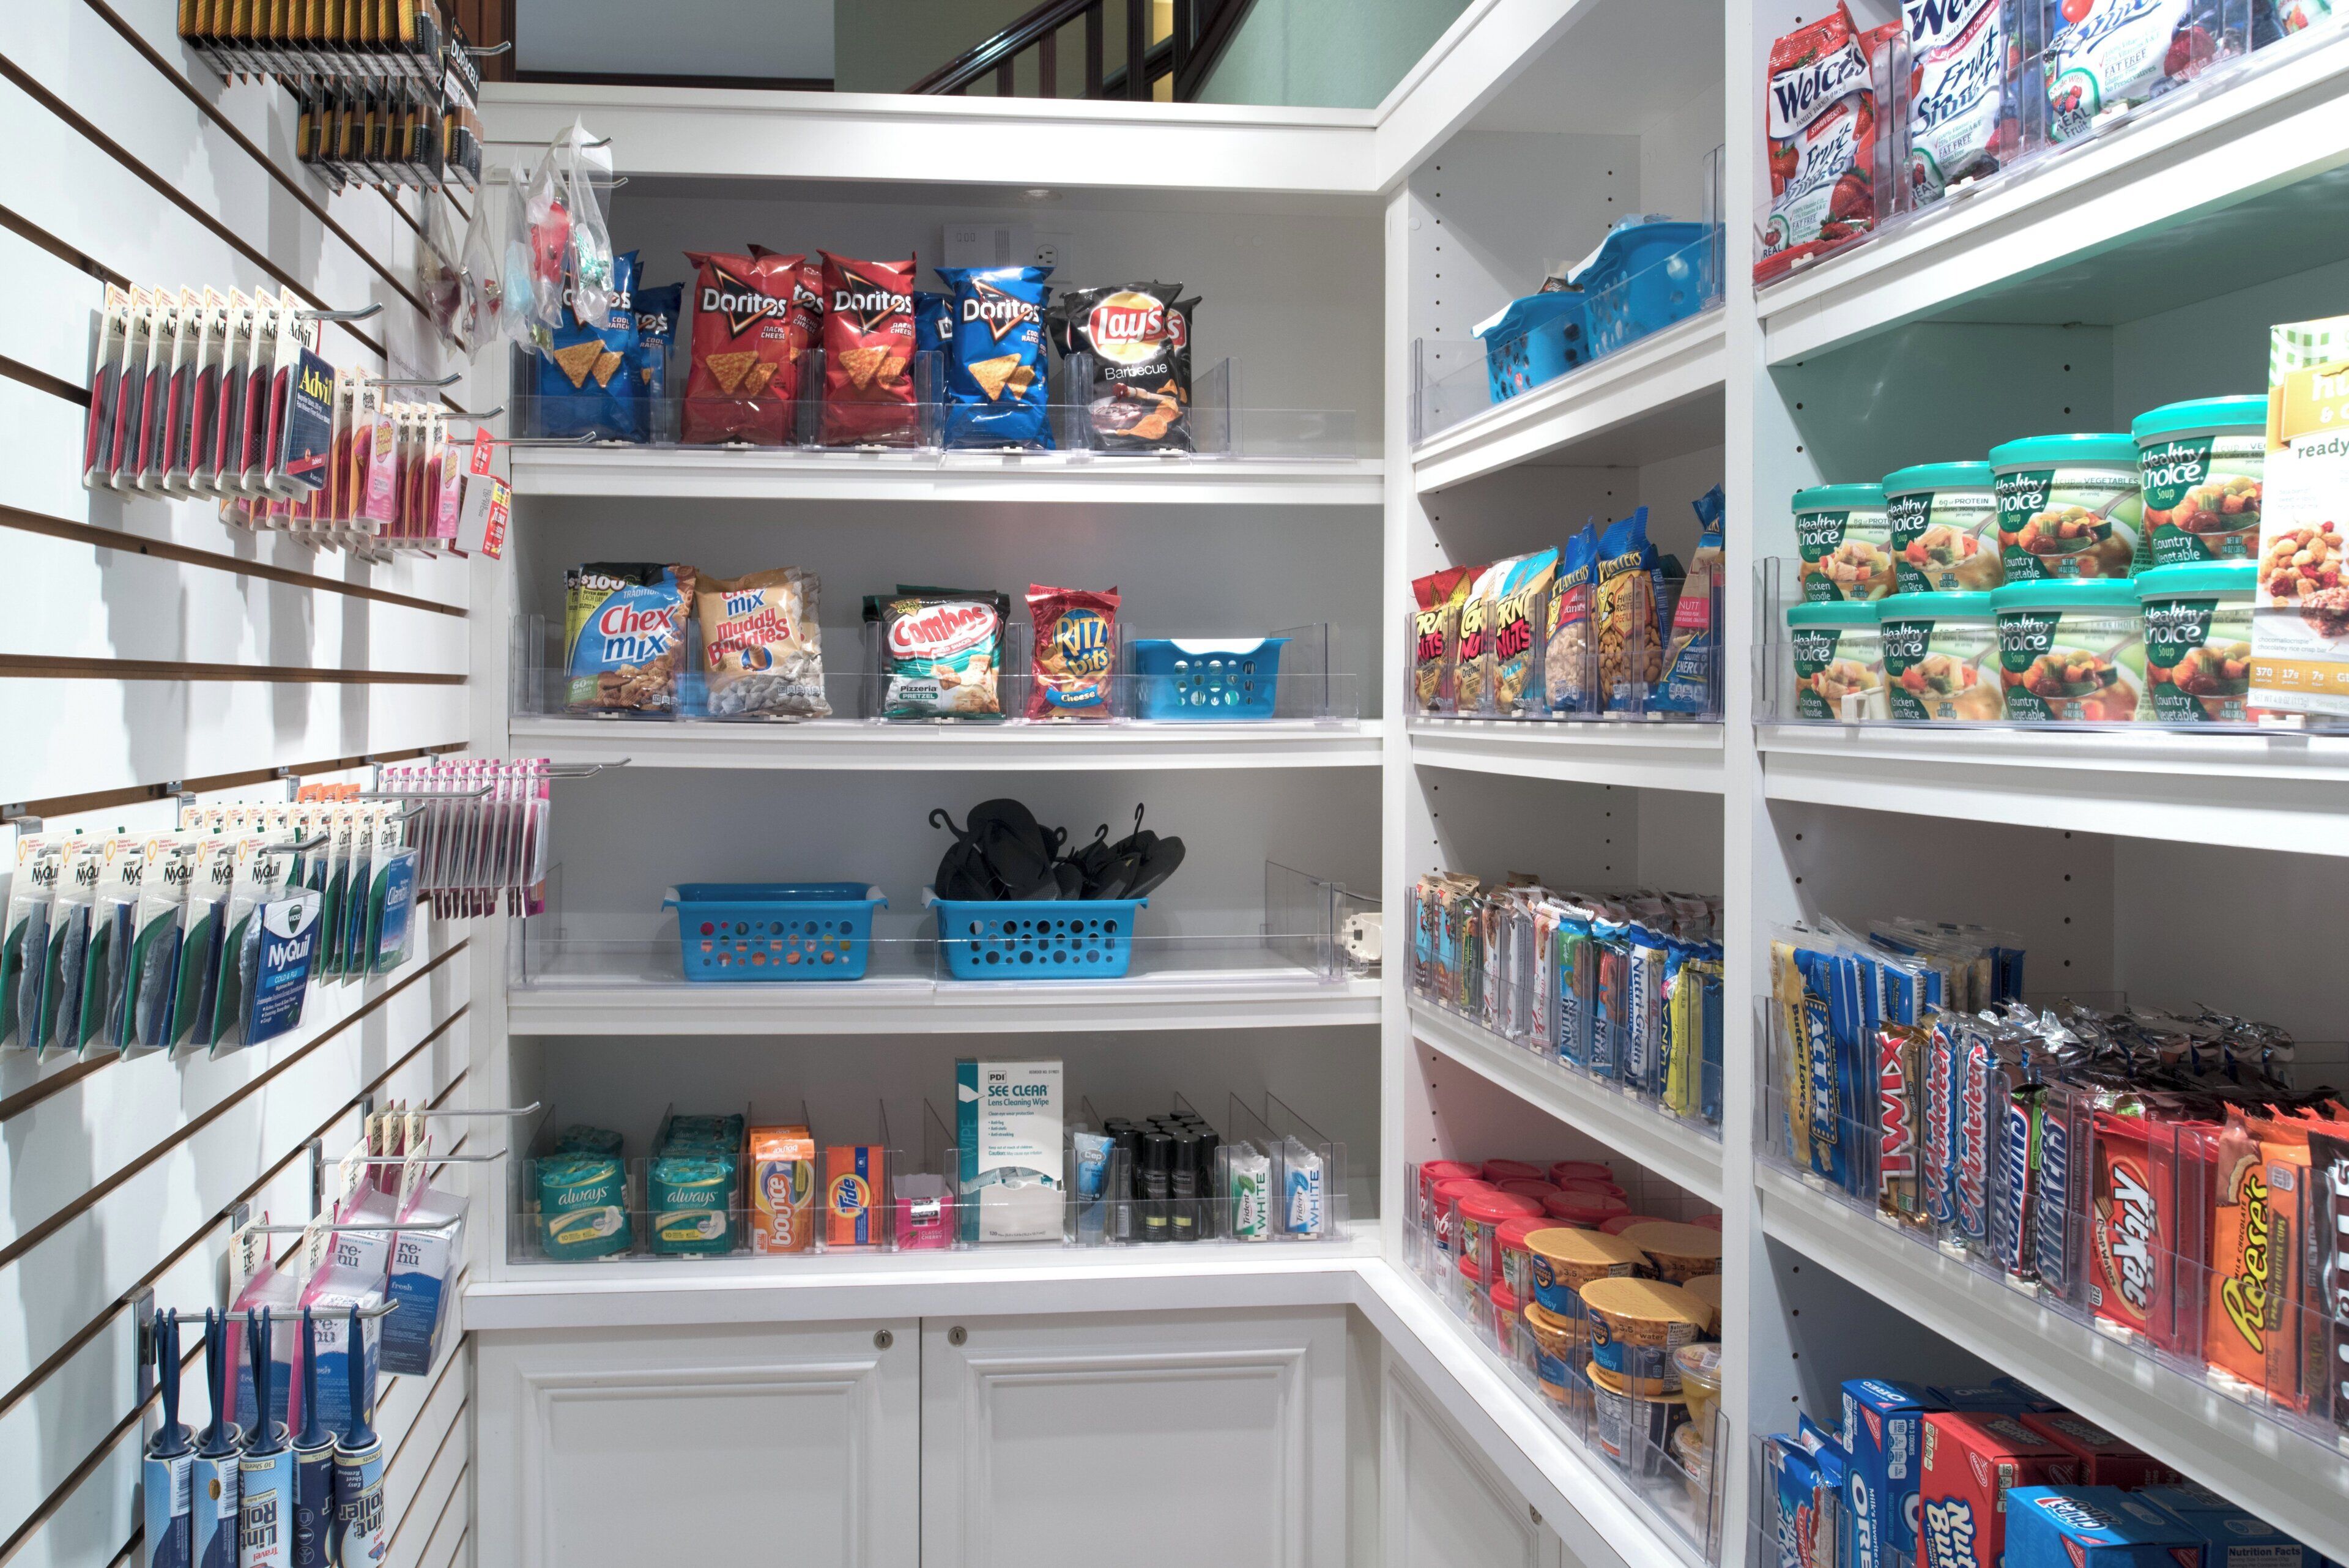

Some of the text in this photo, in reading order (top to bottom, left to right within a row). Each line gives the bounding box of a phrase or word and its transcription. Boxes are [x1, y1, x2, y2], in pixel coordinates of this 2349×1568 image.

[451, 38, 479, 92] DURACELL
[1931, 24, 1999, 100] Fruit
[2105, 49, 2147, 78] FAT FREE
[2113, 65, 2157, 89] Preservatives
[1811, 106, 1842, 135] STRAWBERRY
[2057, 107, 2091, 131] REAL
[2063, 120, 2091, 138] Fruit
[1802, 122, 1852, 181] Fruit
[1939, 134, 1973, 157] FAT FREE
[1803, 215, 1817, 226] FREE
[1763, 245, 1783, 258] REAL
[702, 288, 788, 318] Doritos
[834, 289, 912, 314] Doritos
[963, 298, 1039, 324] Doritos
[792, 318, 817, 335] CHEESE
[796, 313, 818, 327] NACHO
[1100, 303, 1165, 346] Lay's
[289, 319, 312, 349] Advil
[646, 336, 665, 345] COOL
[889, 328, 913, 337] CHEESE
[1104, 362, 1168, 381] Barbecue
[299, 364, 333, 406] Advil
[2141, 442, 2205, 468] Healthy
[2298, 437, 2349, 459] ready
[1995, 472, 2047, 496] Healthy
[2142, 463, 2203, 490] Choice
[2158, 488, 2175, 501] Soup
[1798, 513, 1843, 531] Healthy
[2007, 513, 2021, 525] Soup
[1798, 529, 1839, 546] Choice
[1896, 533, 1908, 543] Soup
[2153, 535, 2192, 551] Country
[1809, 546, 1821, 556] Soup
[1598, 552, 1642, 581] PLANTERS
[2004, 557, 2033, 568] Country
[581, 574, 625, 590] $100
[1553, 565, 1589, 596] PLANTERS
[1806, 582, 1830, 592] Chicken
[1896, 571, 1918, 582] Chicken
[1909, 582, 1924, 592] Rice
[727, 592, 765, 618] mix
[1809, 592, 1831, 601] Noodle
[599, 604, 675, 636] Chex
[1999, 613, 2050, 635] Healthy
[2144, 601, 2205, 626] Healthy
[894, 604, 988, 647] Combos
[2143, 623, 2203, 645] Choice
[604, 633, 672, 662] mix
[707, 618, 791, 668] Buddies
[1056, 617, 1106, 658] RITZ
[1998, 631, 2049, 652] Choice
[1068, 646, 1108, 675] bits
[2011, 652, 2025, 664] Soup
[2158, 645, 2175, 658] Soup
[1892, 658, 1904, 668] Soup
[2256, 667, 2325, 680] 370 17g 7g
[572, 679, 593, 689] 60%
[1061, 690, 1096, 703] Cheese
[1801, 697, 1822, 707] Chicken
[1891, 697, 1915, 707] Chicken
[2008, 696, 2039, 709] Country
[2154, 695, 2191, 710] Country
[1904, 708, 1920, 719] Rice
[251, 862, 280, 886] NyQuil
[289, 913, 302, 921] VICKS
[267, 934, 311, 972] NyQuil
[274, 973, 286, 984] COLD
[1792, 1003, 1807, 1123] Butter Lovers
[1809, 1011, 1829, 1126] ACT II
[988, 1084, 1048, 1098] SEE CLEAR
[988, 1098, 1050, 1108] Lens Cleaning Wipe
[1879, 1031, 1916, 1194] TWIX
[1926, 1028, 1950, 1192] Musketeers
[1959, 1040, 1987, 1206] Musketeers
[773, 1144, 798, 1154] bounce
[961, 1118, 977, 1161] WIPE
[558, 1185, 607, 1206] always
[667, 1187, 716, 1208] always
[837, 1176, 857, 1212] Tide
[1256, 1172, 1266, 1230] WHITE
[1310, 1170, 1319, 1227] WHITE
[769, 1176, 793, 1246] bounce
[2237, 1200, 2247, 1254] CHOCOLATE
[2277, 1219, 2286, 1244] CUPS
[338, 1254, 359, 1268] nu
[397, 1254, 420, 1266] nu
[2221, 1173, 2268, 1354] Reese's
[1564, 1269, 1578, 1277] 3.5
[390, 1282, 412, 1292] fresh
[1540, 1296, 1557, 1311] easy
[314, 1331, 336, 1343] nu
[1619, 1324, 1634, 1333] 3.5
[1598, 1357, 1617, 1370] easy
[1863, 1381, 1909, 1403] OREO
[1866, 1410, 1880, 1439] NABISCO
[1971, 1454, 1987, 1485] NABISCO
[241, 1523, 278, 1551] Lint
[1870, 1510, 1879, 1558] Favorite
[253, 1546, 278, 1562] Travel
[2228, 1547, 2301, 1556] Nutrition Facts
